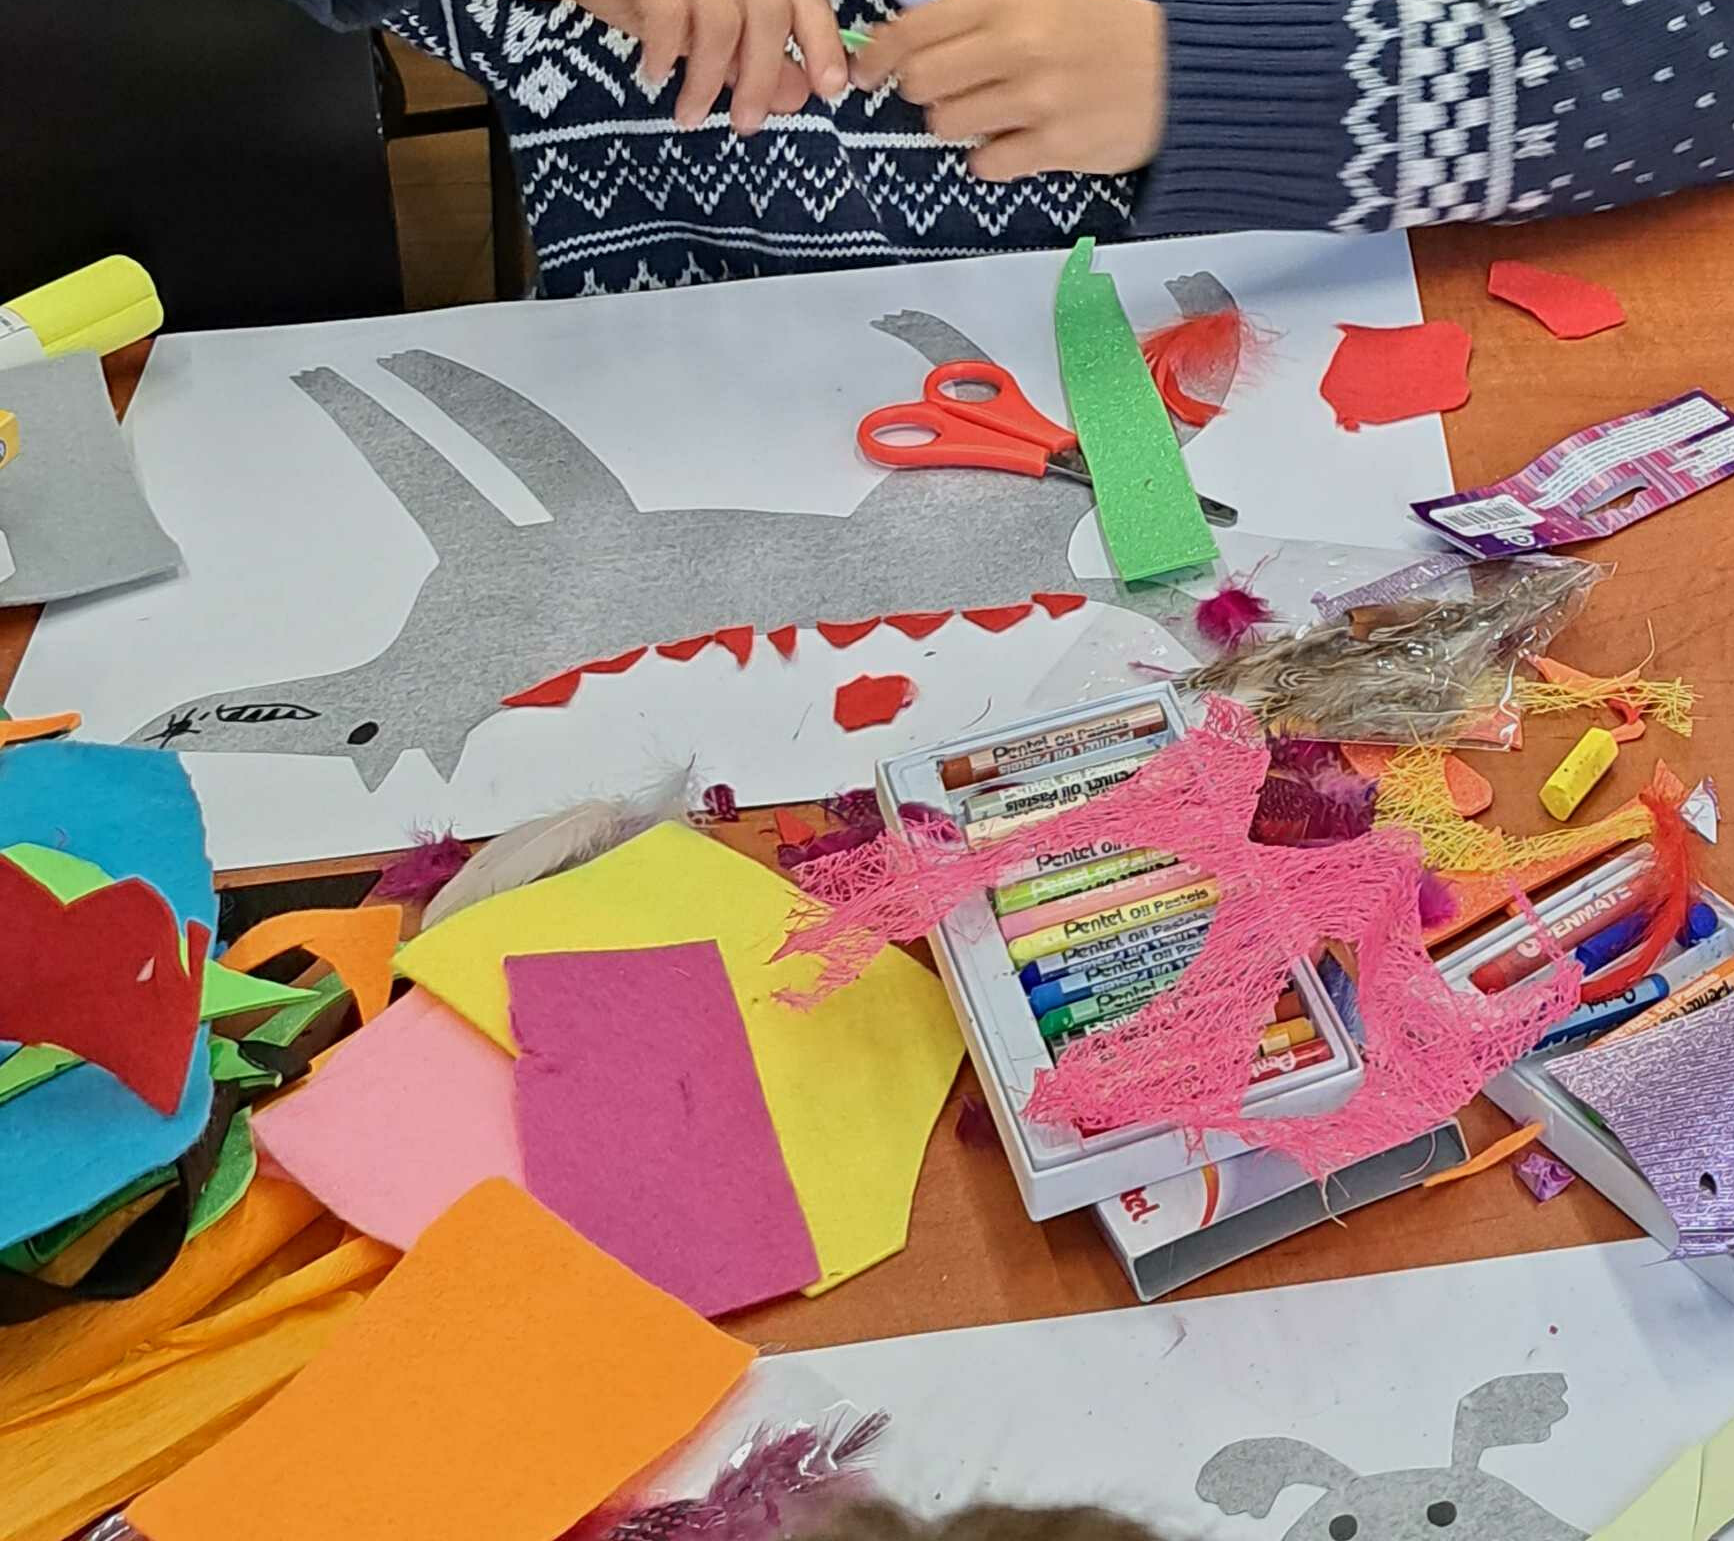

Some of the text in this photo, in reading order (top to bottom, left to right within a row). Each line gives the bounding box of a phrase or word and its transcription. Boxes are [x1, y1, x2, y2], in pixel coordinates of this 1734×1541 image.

[992, 734, 1050, 763] Pentel
[1036, 846, 1098, 871] Pentel
[1063, 888, 1208, 938] Pentel Oil Pastels
[1061, 936, 1124, 963] Pentel
[1128, 928, 1150, 943] Oil
[1085, 956, 1141, 983] Pentel
